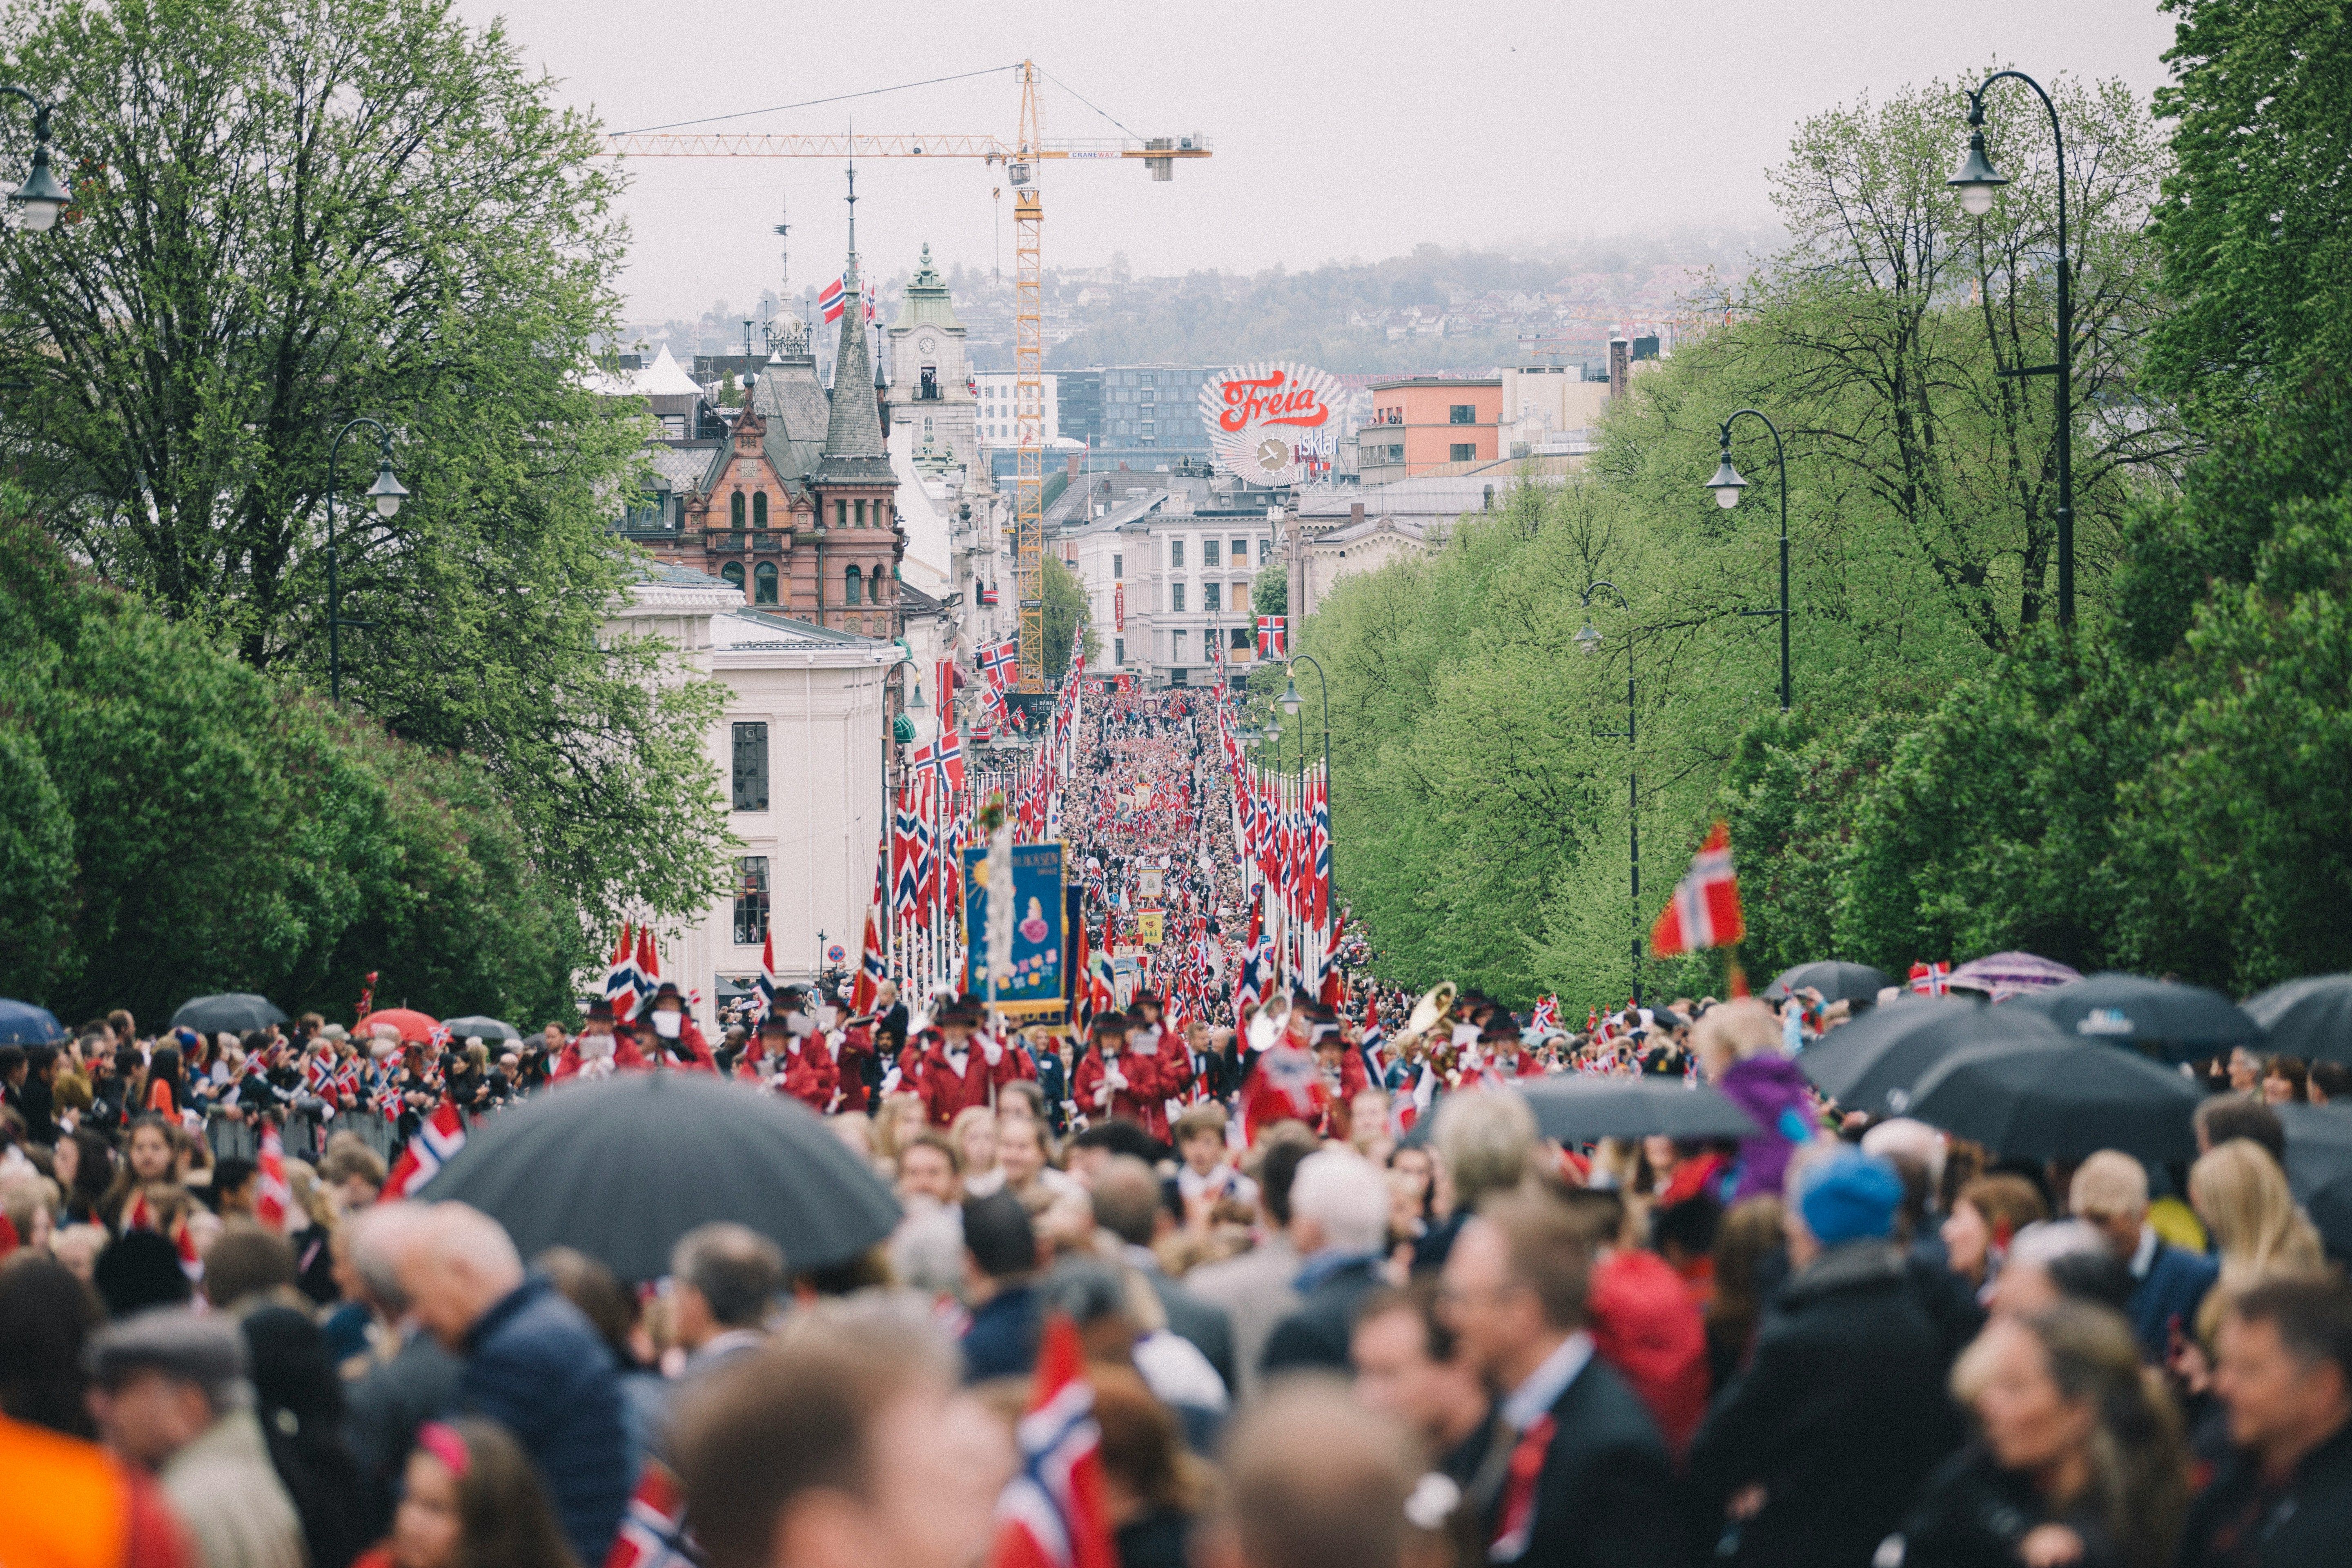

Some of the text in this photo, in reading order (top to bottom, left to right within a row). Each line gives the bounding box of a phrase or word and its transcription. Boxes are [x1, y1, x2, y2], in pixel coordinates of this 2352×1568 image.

[1219, 370, 1328, 432] Freia
[1299, 429, 1340, 456] isklar
[741, 469, 757, 477] 1897
